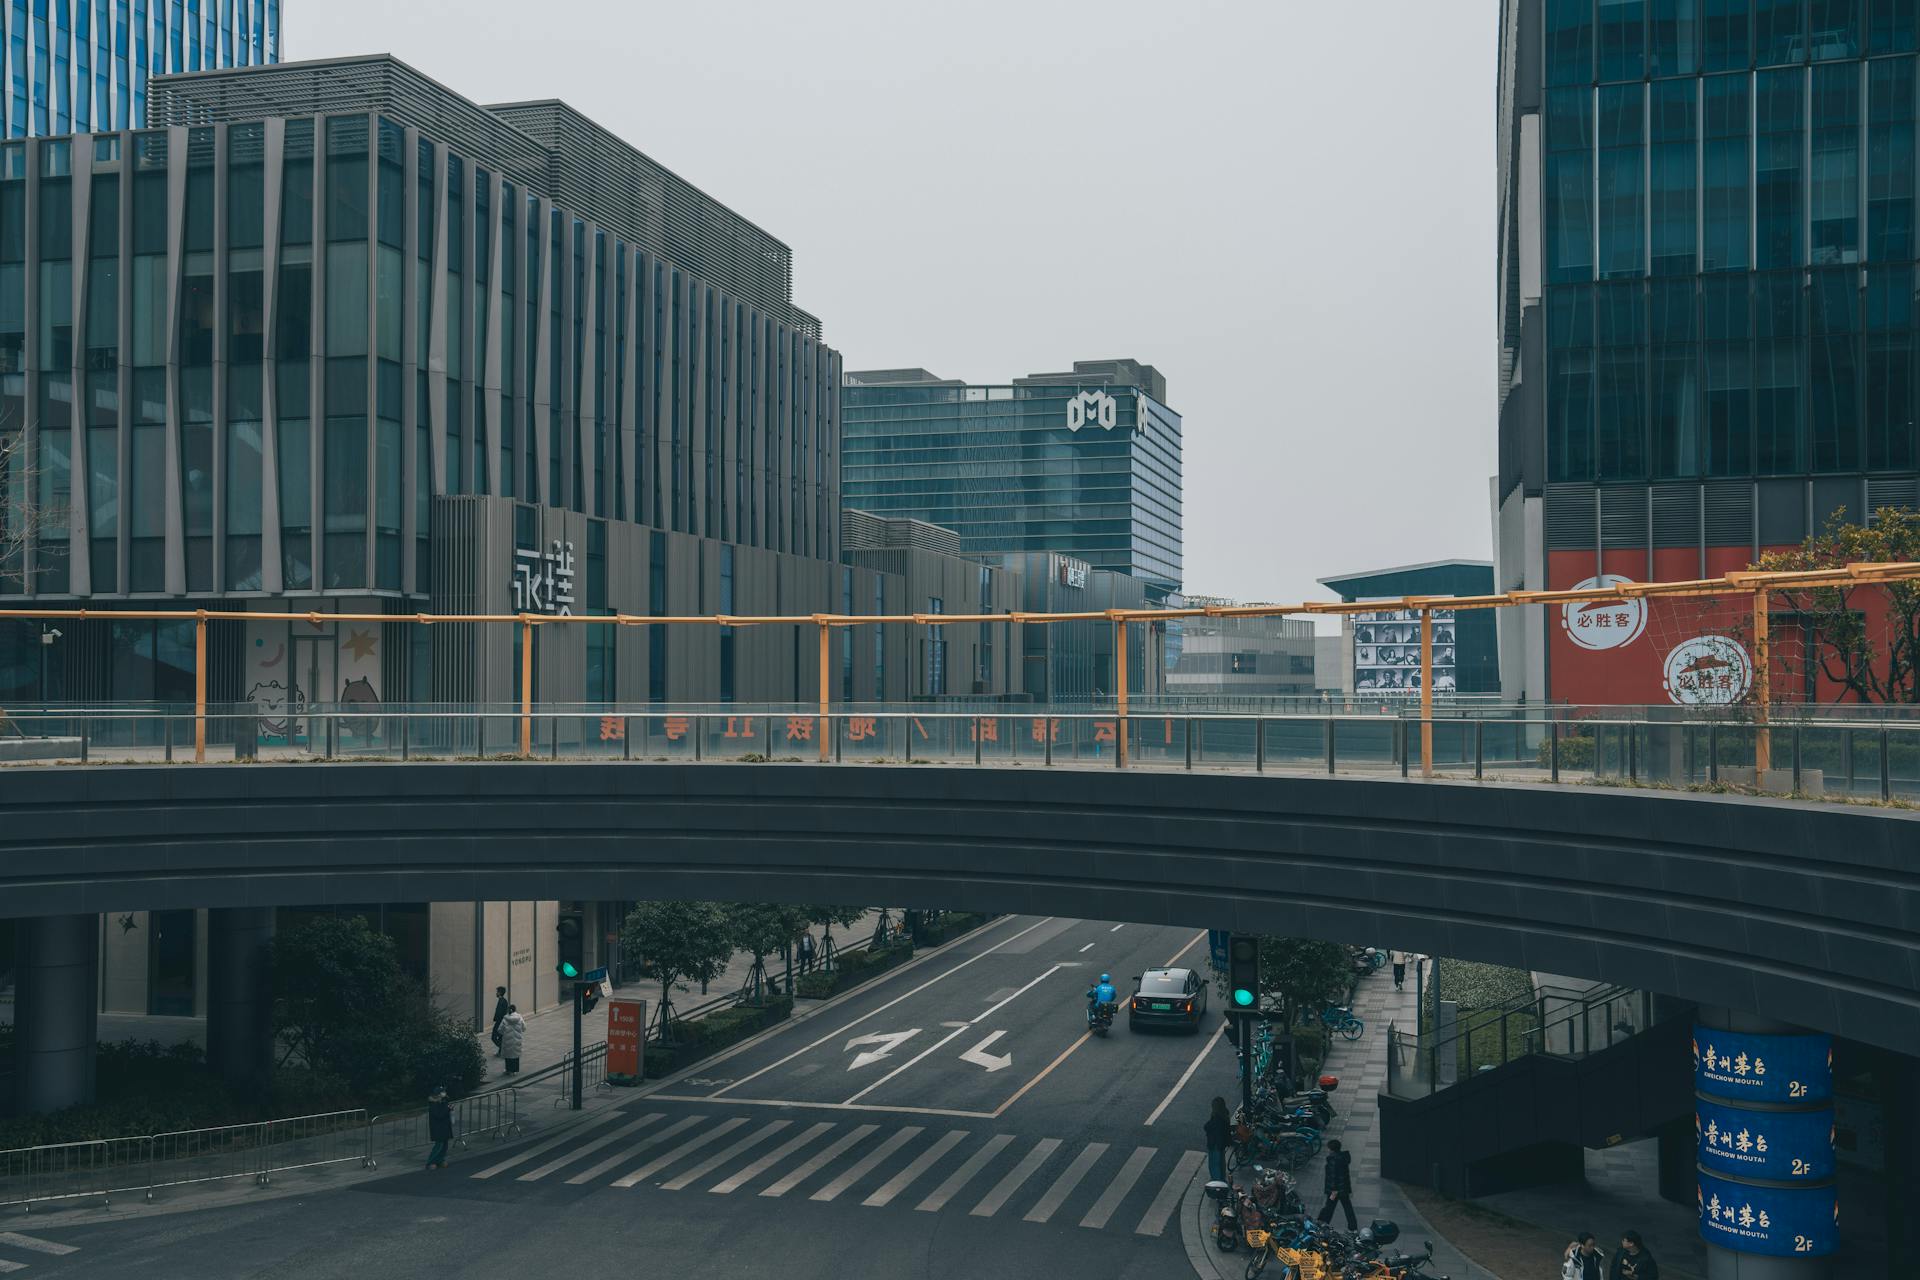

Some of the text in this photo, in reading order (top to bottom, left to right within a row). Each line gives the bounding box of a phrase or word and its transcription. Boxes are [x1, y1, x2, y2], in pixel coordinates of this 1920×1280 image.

[1577, 612, 1630, 628] 必胜客
[1704, 1071, 1764, 1086] KWEICHOW MOUTAI
[1789, 1081, 1808, 1097] 2F
[1705, 1146, 1765, 1163] KWEICHOW MOUTAI
[1791, 1158, 1810, 1175] 2F
[1708, 1220, 1768, 1239] KWEICHOW MOUTAI
[1794, 1235, 1813, 1252] 2F
